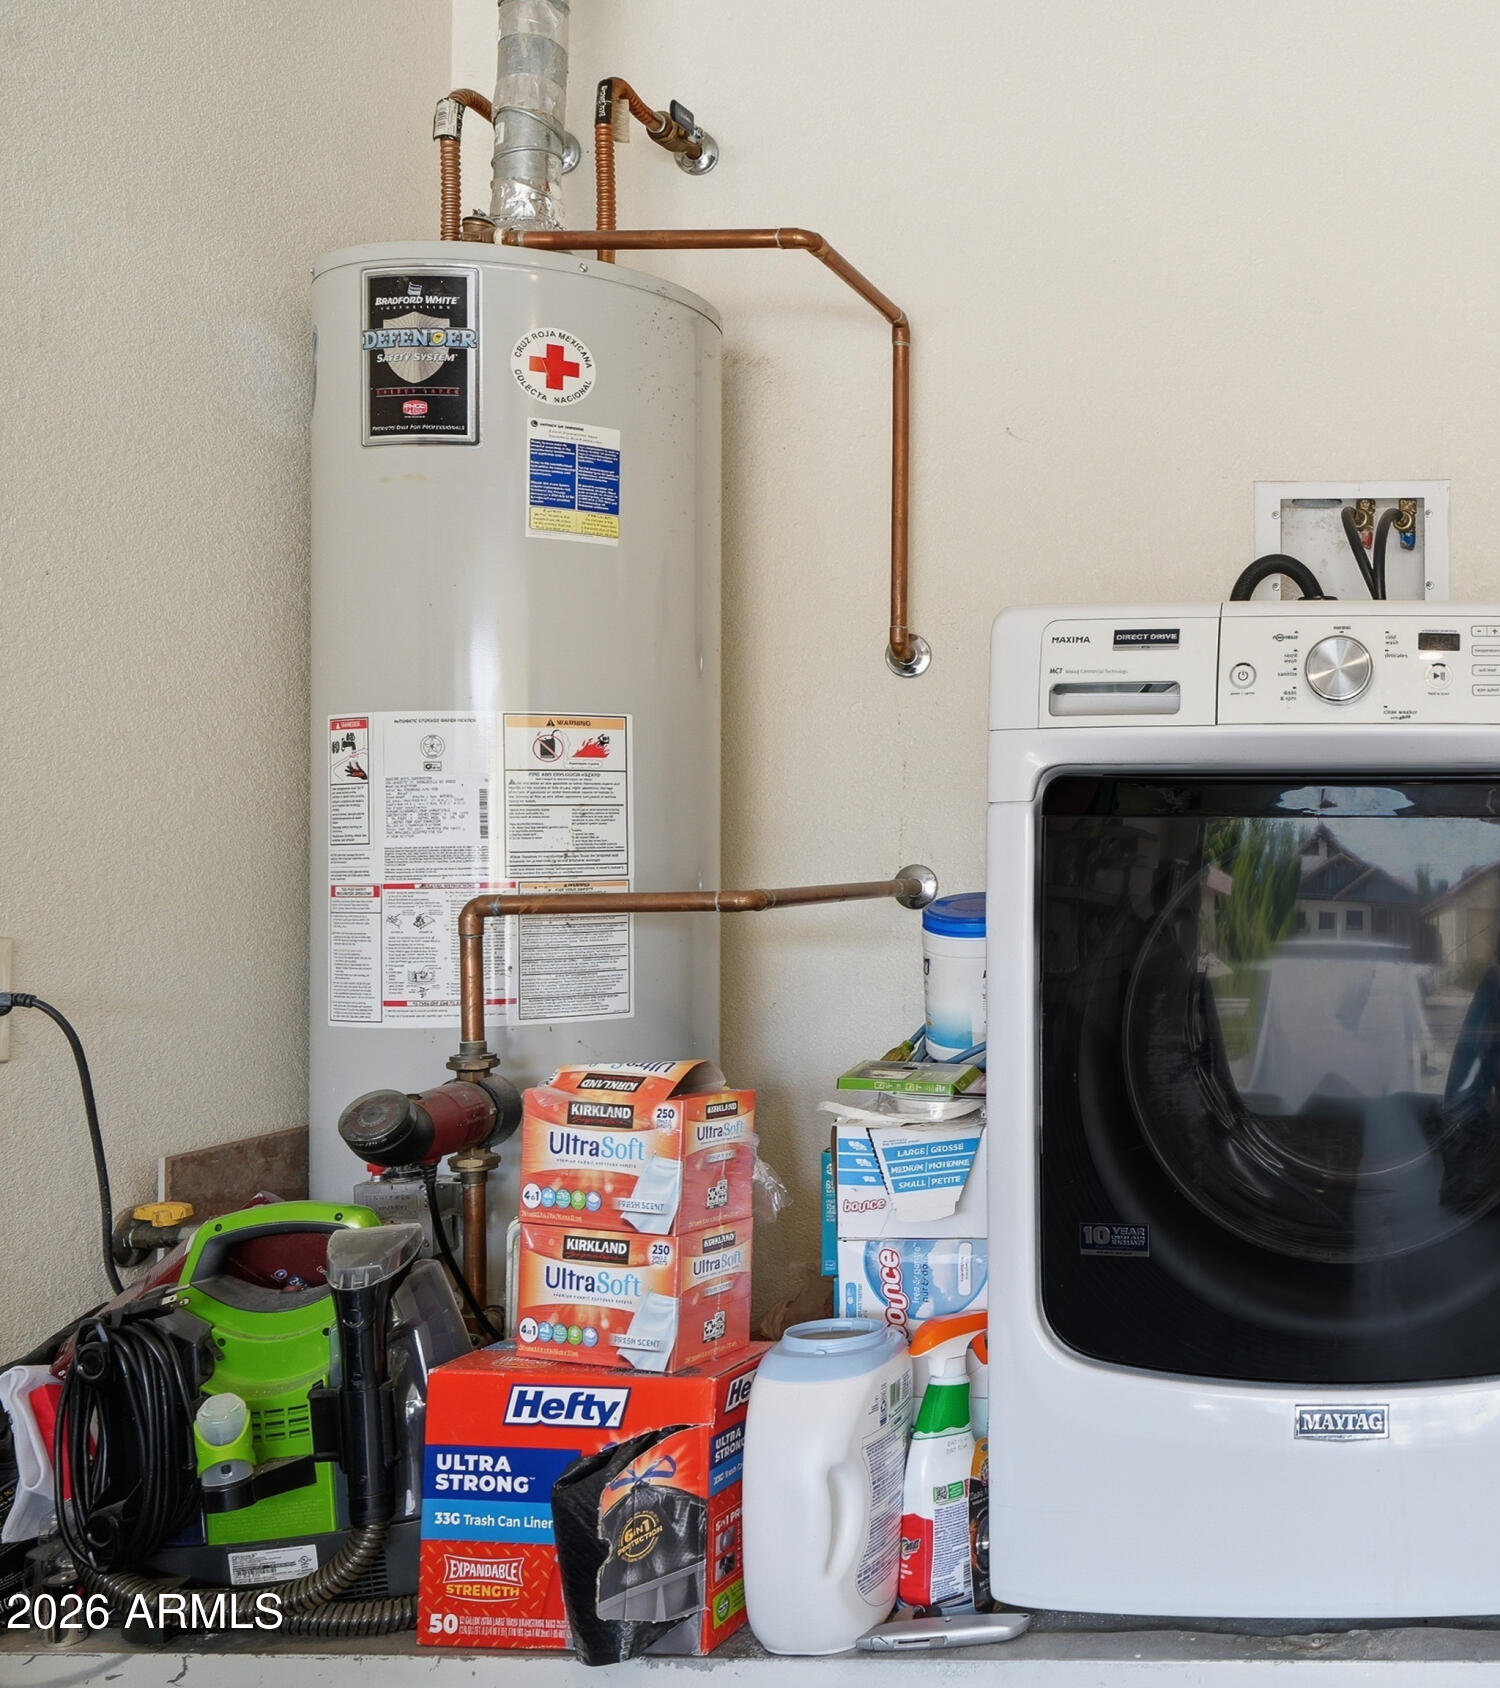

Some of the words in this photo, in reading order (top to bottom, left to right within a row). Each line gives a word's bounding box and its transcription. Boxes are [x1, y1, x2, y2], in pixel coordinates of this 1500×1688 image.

[375, 296, 423, 306] BRADFORD
[425, 296, 457, 305] WHITE
[362, 328, 477, 350] DEFENDER
[514, 337, 532, 358] CRUZ
[531, 330, 556, 340] ROJA
[558, 332, 593, 368] MEXICANA
[376, 353, 410, 363] SAFETY
[413, 353, 455, 362] SYSTEM
[514, 369, 548, 401] COLECTA
[554, 380, 592, 403] NACIONAL
[1051, 636, 1091, 644] MAXIMA
[580, 1079, 639, 1092] KIRKLAND
[570, 1103, 632, 1119] KIRKLAND
[656, 1108, 675, 1119] 250
[897, 1148, 926, 1158] LARGE
[930, 1143, 964, 1154] GROSSE
[890, 1164, 924, 1174] MEDIUM
[898, 1179, 926, 1189] SMALL
[641, 1202, 665, 1211] SCENT
[843, 1199, 887, 1213] bounce
[1083, 1225, 1111, 1245] 10
[1111, 1226, 1145, 1235] YEAR
[565, 1237, 628, 1255] KIRKLAND
[652, 1244, 670, 1255] 250
[636, 1338, 661, 1348] SCENT
[512, 1390, 621, 1427] Hefty
[1301, 1413, 1384, 1430] MAYTAG
[715, 1427, 742, 1449] ULTRA
[436, 1453, 512, 1473] ULTRA
[435, 1473, 530, 1494] STRONG
[434, 1511, 461, 1526] 33G
[463, 1513, 495, 1527] Trash
[497, 1515, 521, 1528] Can
[450, 1560, 519, 1581] EXPANDABLE
[445, 1584, 520, 1598] STRENGTH
[428, 1613, 459, 1634] 50
